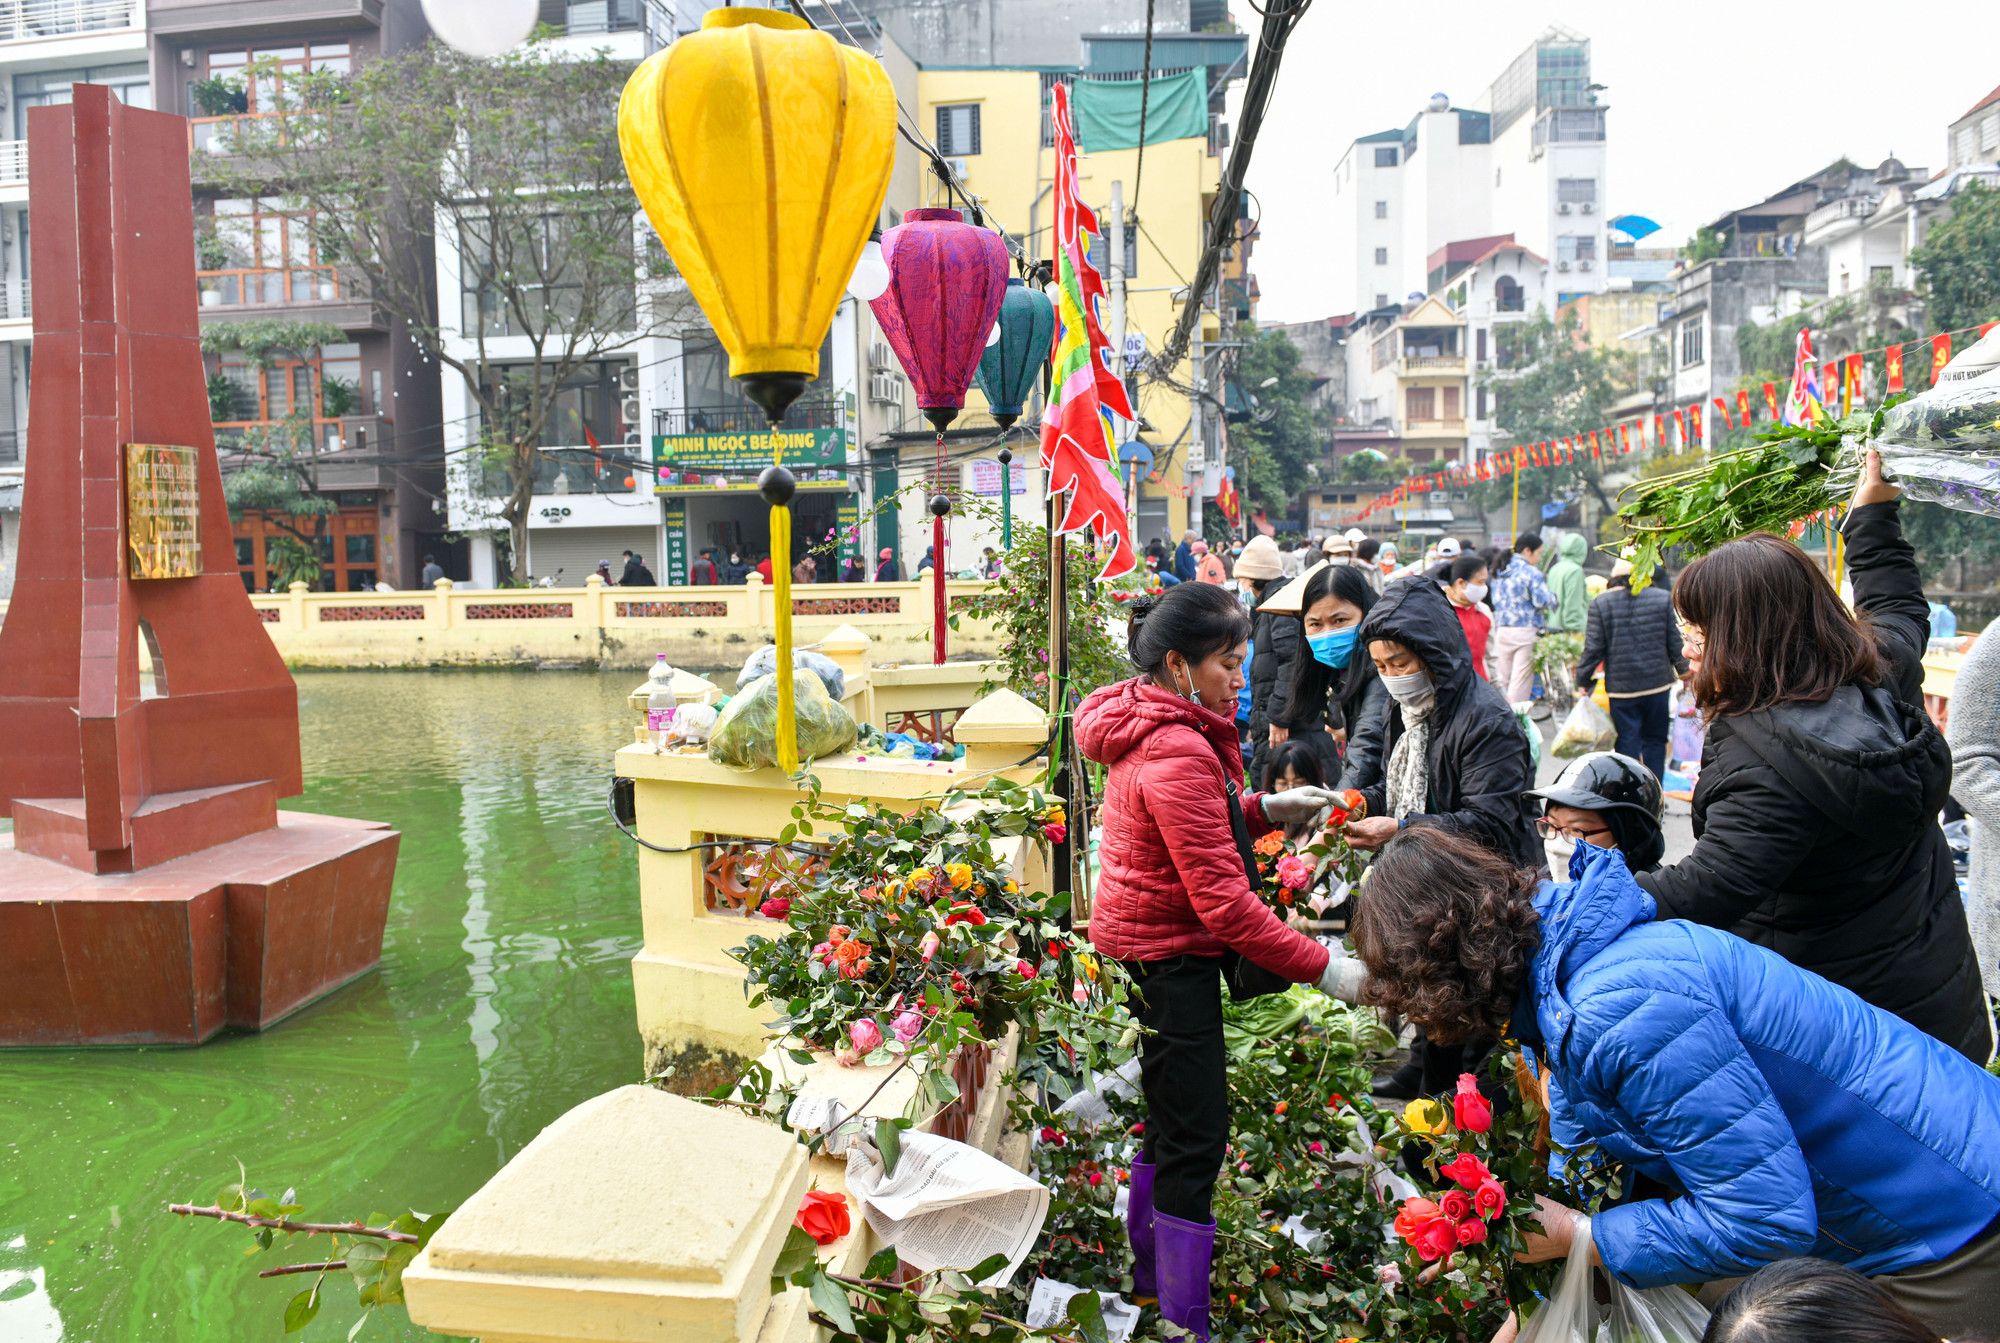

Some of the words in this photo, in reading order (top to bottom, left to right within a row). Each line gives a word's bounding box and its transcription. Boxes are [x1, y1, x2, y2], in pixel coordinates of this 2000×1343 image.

[664, 437, 705, 453] MINH
[707, 435, 748, 455] NGỌC
[749, 432, 815, 451] BEADING
[137, 463, 150, 479] DI
[540, 507, 571, 517] 420
